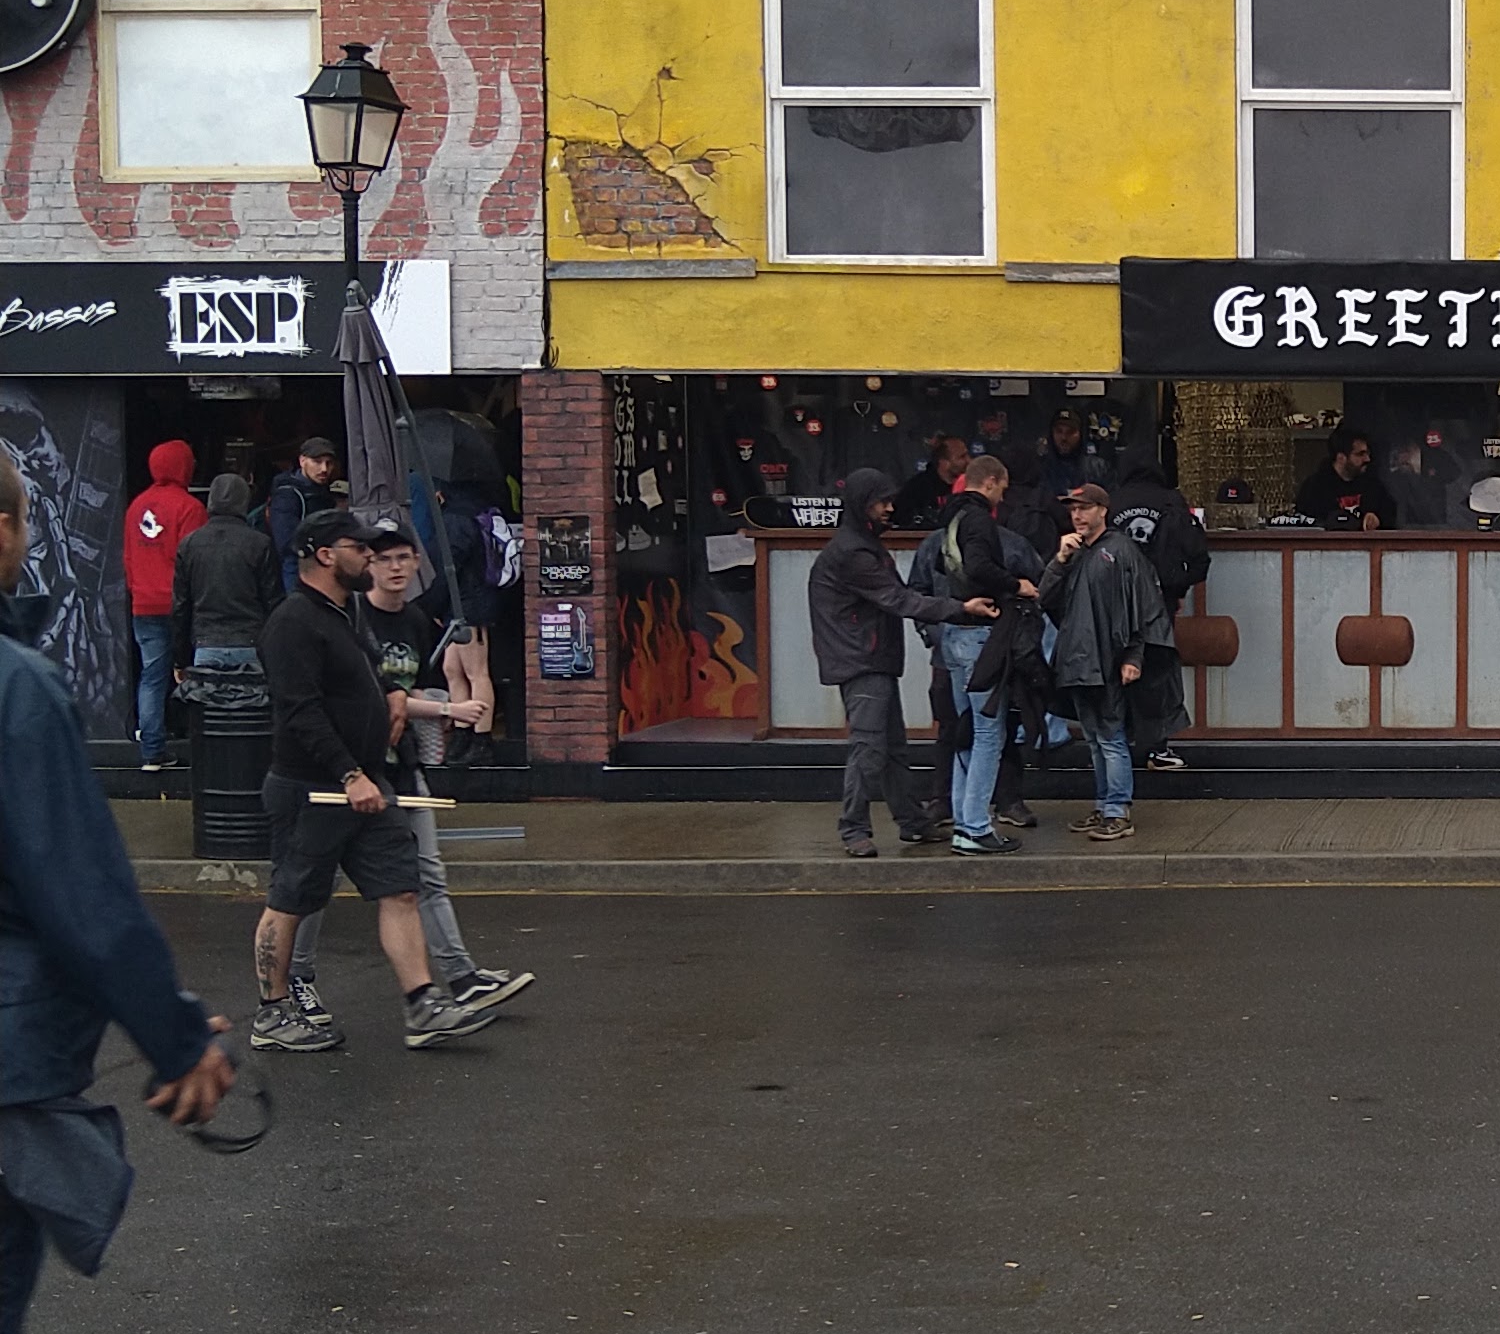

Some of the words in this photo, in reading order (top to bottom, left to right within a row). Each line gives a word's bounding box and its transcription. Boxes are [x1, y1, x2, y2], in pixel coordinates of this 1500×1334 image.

[0, 297, 117, 336] Basses
[178, 291, 299, 344] ESP
[792, 497, 826, 506] LISTEN
